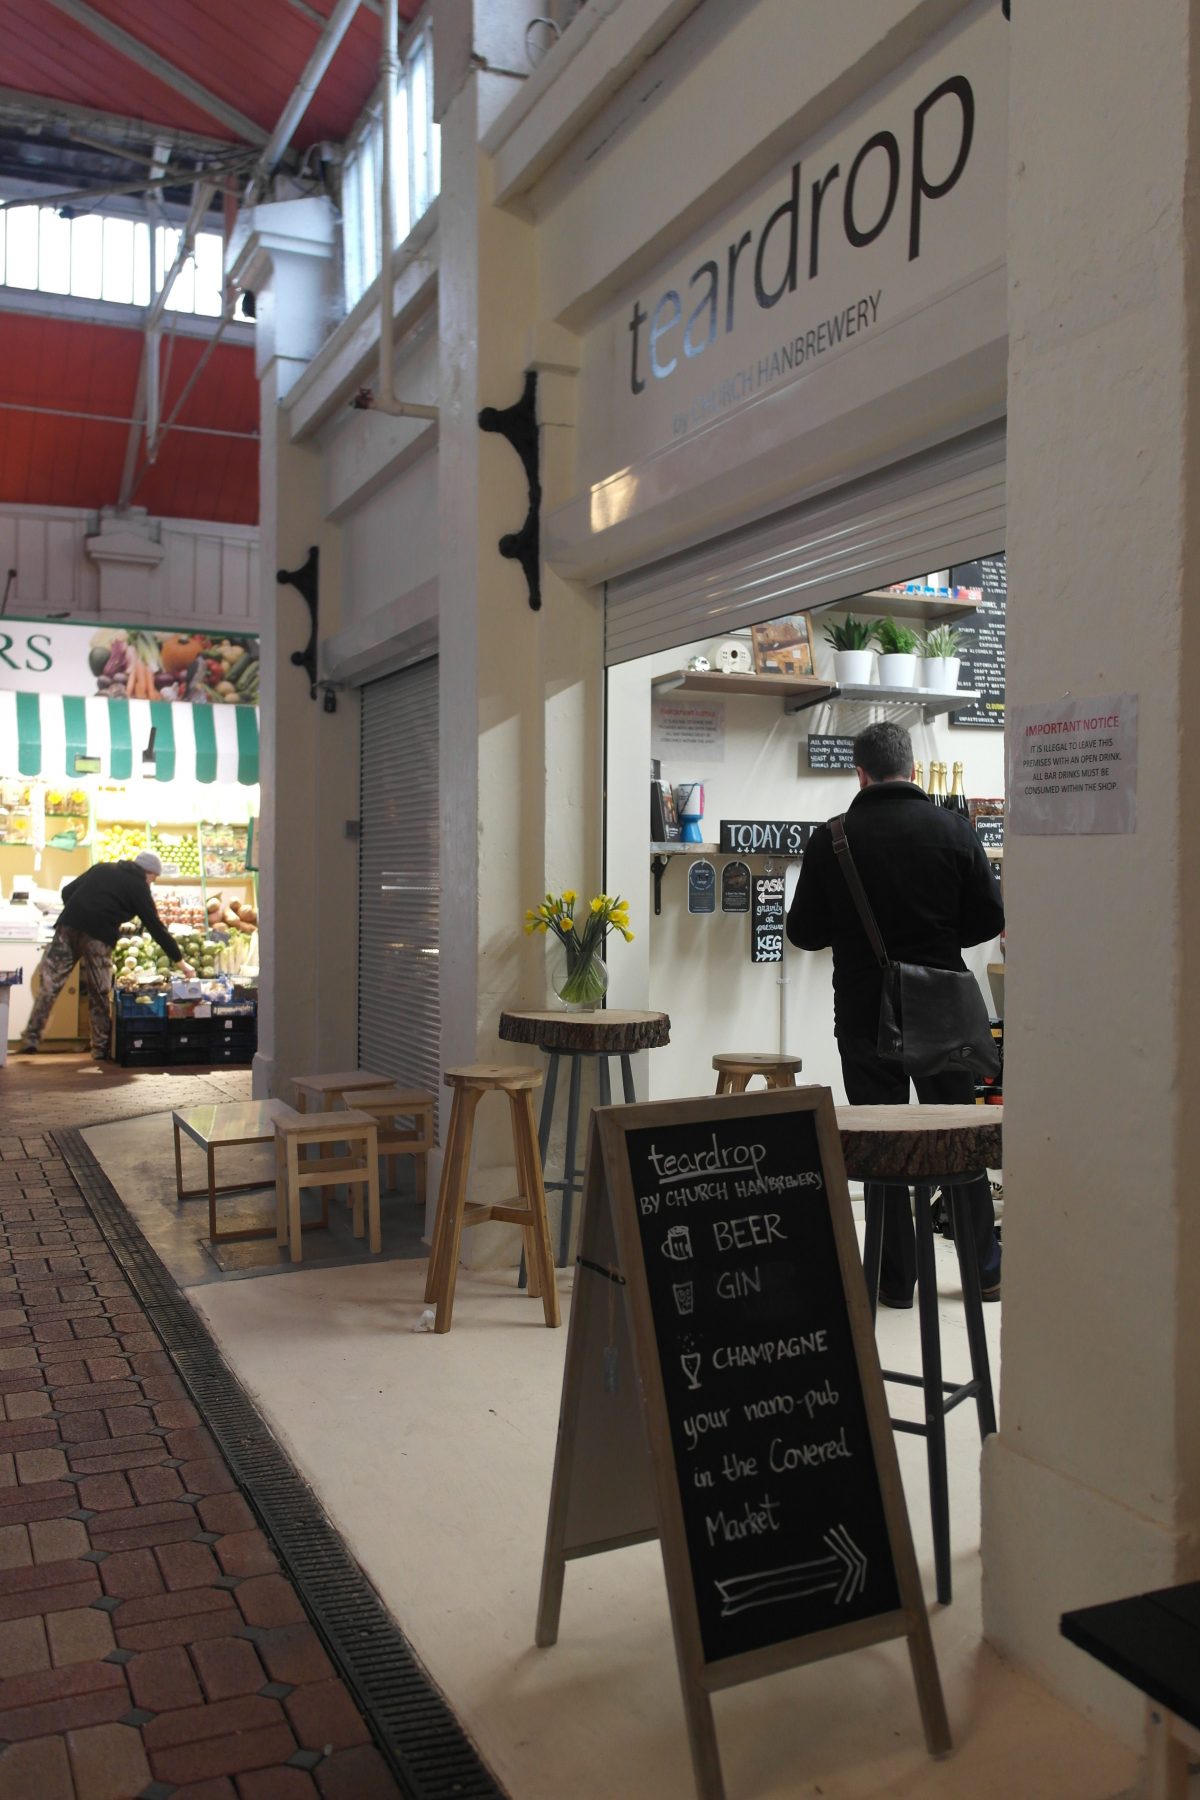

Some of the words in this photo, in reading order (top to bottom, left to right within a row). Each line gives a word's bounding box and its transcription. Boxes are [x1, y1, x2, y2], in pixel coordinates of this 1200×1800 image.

[629, 75, 974, 395] teardrop
[690, 365, 753, 423] CHURCH
[757, 289, 882, 387] HANBREWERY
[1025, 719, 1081, 737] IMPORTANT
[1083, 715, 1120, 730] NOTICE
[1023, 758, 1052, 767] PREMISES
[1052, 757, 1069, 766] WITH
[1070, 756, 1079, 764] AN
[1081, 754, 1097, 763] OPEN
[1030, 745, 1036, 753] IT
[1037, 745, 1043, 753] IS
[1043, 743, 1068, 752] ILLEGAL
[1069, 742, 1077, 750] TO
[1079, 740, 1096, 749] LEAVE
[1098, 738, 1113, 747] THIS
[1024, 786, 1060, 795] CONSUMED
[1061, 784, 1084, 793] WITHIN
[1085, 783, 1096, 791] THE
[1033, 773, 1043, 781] ALL
[1045, 772, 1057, 780] BAR
[1058, 770, 1080, 779] DRINKS
[1082, 768, 1099, 777] MUST
[1101, 768, 1109, 776] BE
[727, 824, 802, 849] TODAY'S
[756, 878, 784, 892] CASK
[756, 902, 783, 916] gravity
[757, 935, 782, 950] KEG
[648, 1133, 766, 1185] teardrop
[639, 1193, 661, 1215] BY
[665, 1182, 729, 1207] CHURCH
[734, 1171, 823, 1198] HANBREWERY
[712, 1213, 788, 1252] BEER
[716, 1265, 762, 1299] GIN
[712, 1330, 828, 1369] CHAMPAGNE
[683, 1408, 730, 1451] your
[744, 1379, 839, 1419] nano-pub
[693, 1466, 715, 1488] in
[721, 1454, 758, 1482] the
[769, 1426, 853, 1473] Covered
[705, 1493, 780, 1547] Market
